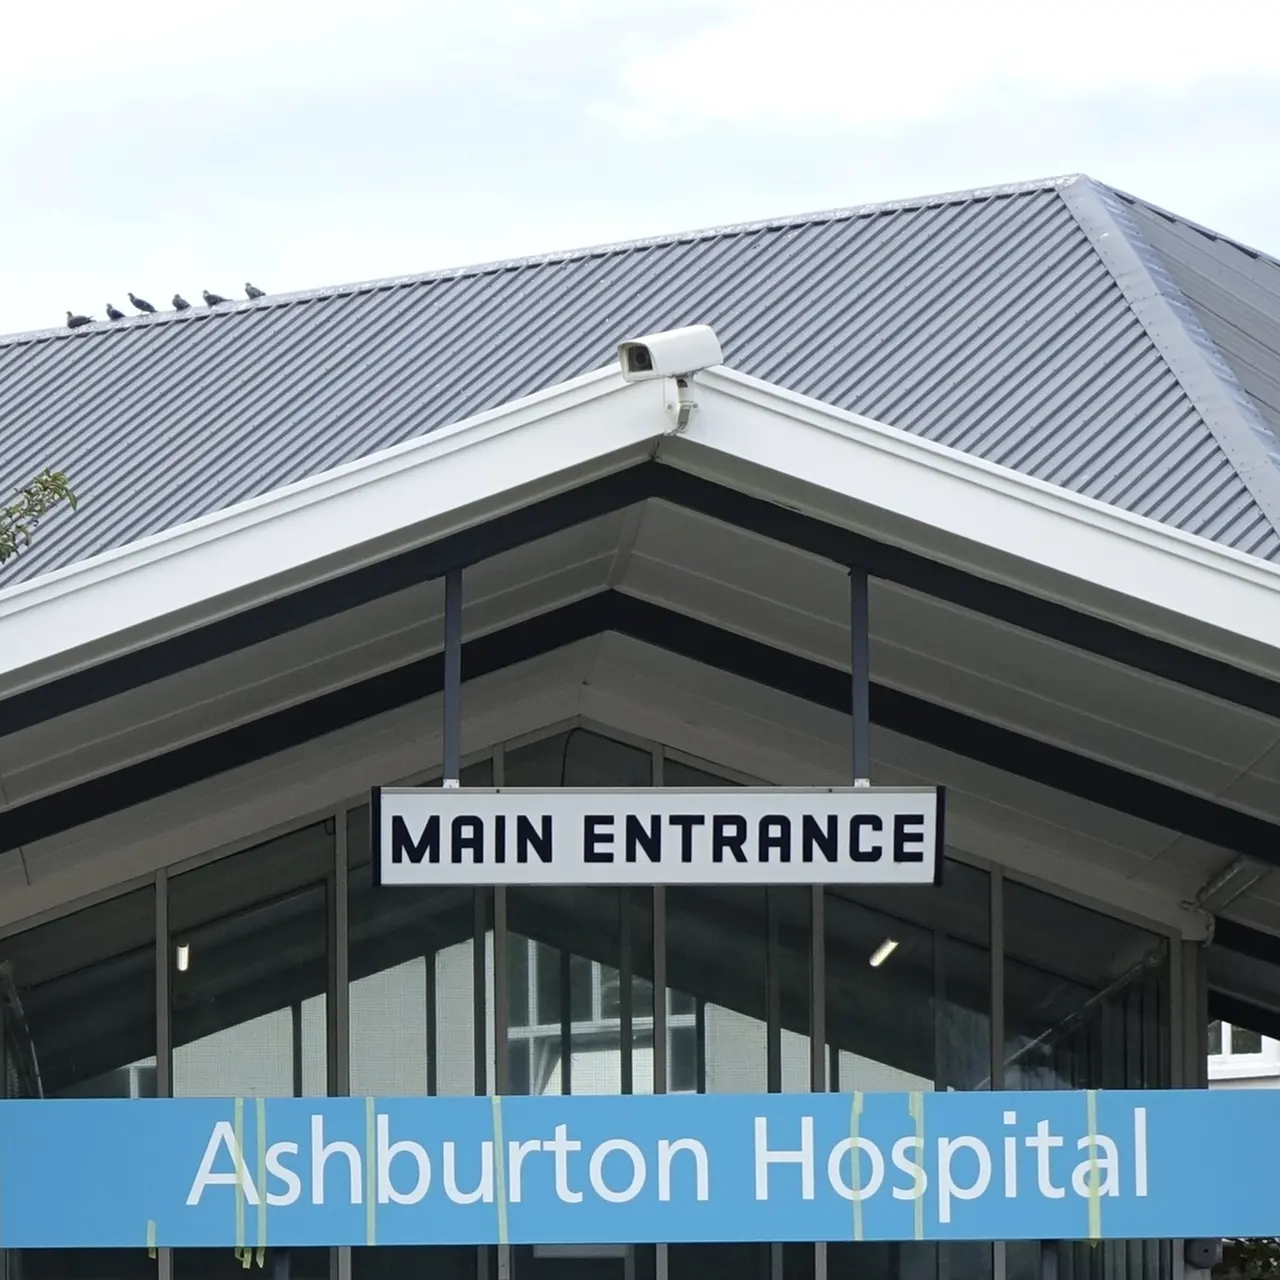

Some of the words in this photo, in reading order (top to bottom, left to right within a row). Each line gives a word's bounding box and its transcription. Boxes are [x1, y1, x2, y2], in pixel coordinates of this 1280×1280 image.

[391, 814, 553, 864] MAIN
[583, 814, 926, 863] ENTRANCE
[186, 1113, 709, 1206] Ashburton
[754, 1107, 1148, 1223] Hospital
